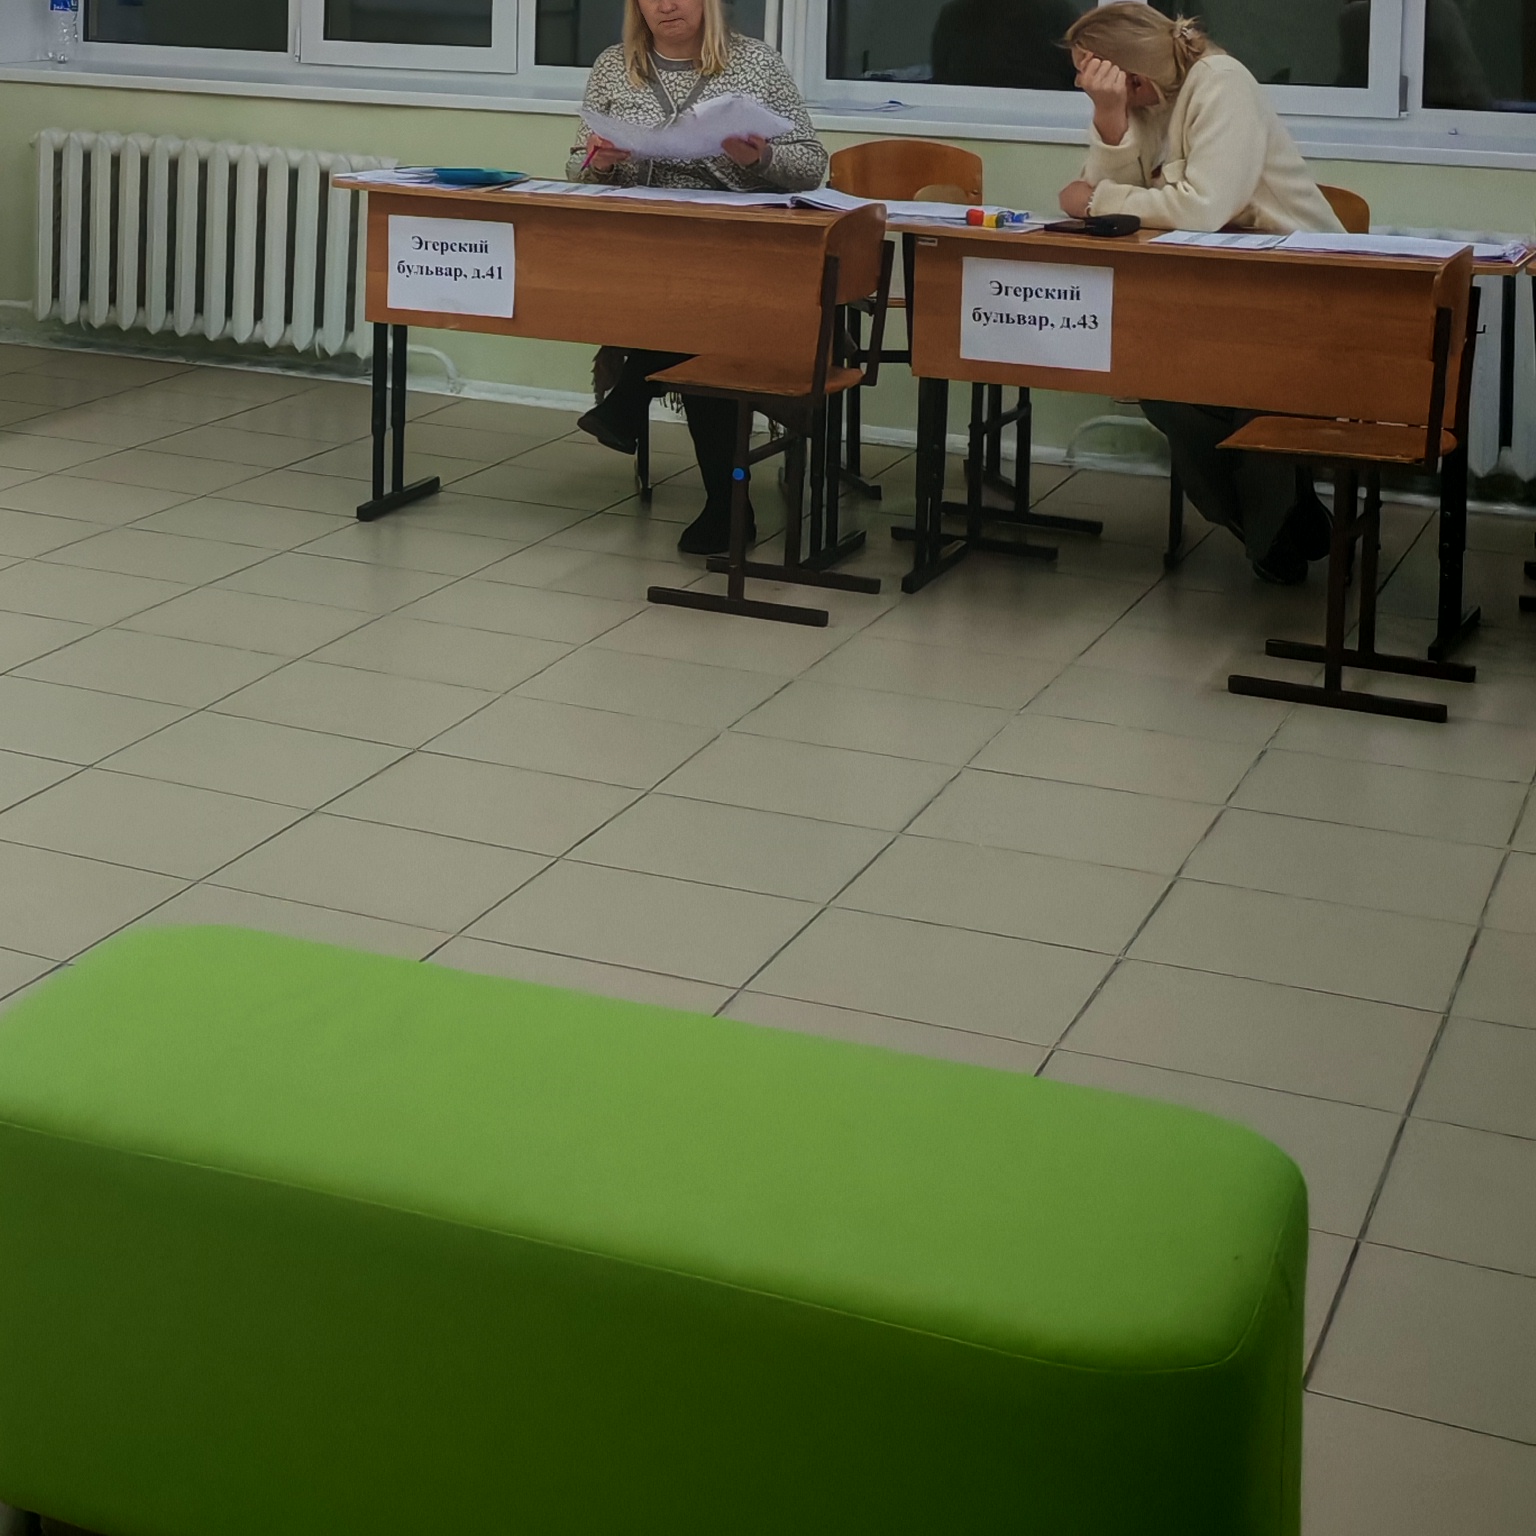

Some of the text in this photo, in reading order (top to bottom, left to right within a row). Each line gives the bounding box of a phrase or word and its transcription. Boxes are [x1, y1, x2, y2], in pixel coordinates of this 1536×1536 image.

[412, 235, 489, 255] Эгерский
[397, 260, 503, 282] бульвар, д.41
[989, 280, 1081, 302] Эгерский
[972, 307, 1099, 331] бульвар, д.43
